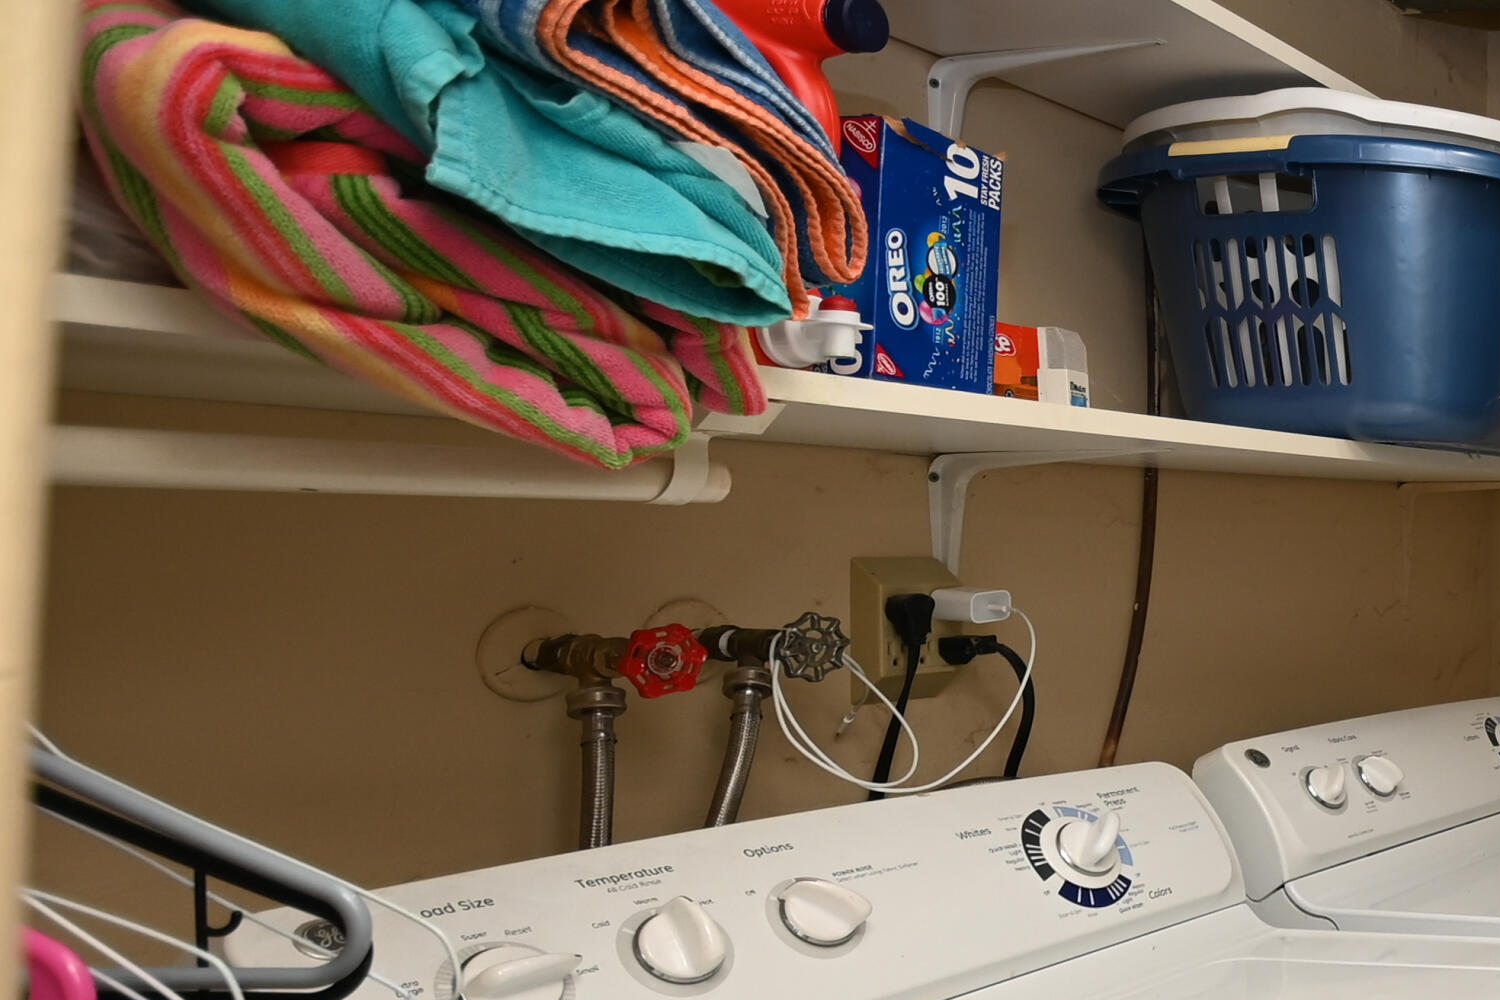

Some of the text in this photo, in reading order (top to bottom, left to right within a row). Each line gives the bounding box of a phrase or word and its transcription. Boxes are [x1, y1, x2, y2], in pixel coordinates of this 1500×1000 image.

[847, 123, 873, 150] NABISCO
[944, 144, 980, 200] 10
[980, 155, 990, 206] STAY FRESH
[988, 158, 1002, 211] PACKS
[887, 230, 915, 326] OREO
[955, 828, 992, 840] Whites
[743, 842, 794, 858] Options
[574, 864, 674, 889] Temperature
[1149, 887, 1173, 900] Colors
[420, 896, 495, 919] oad Size
